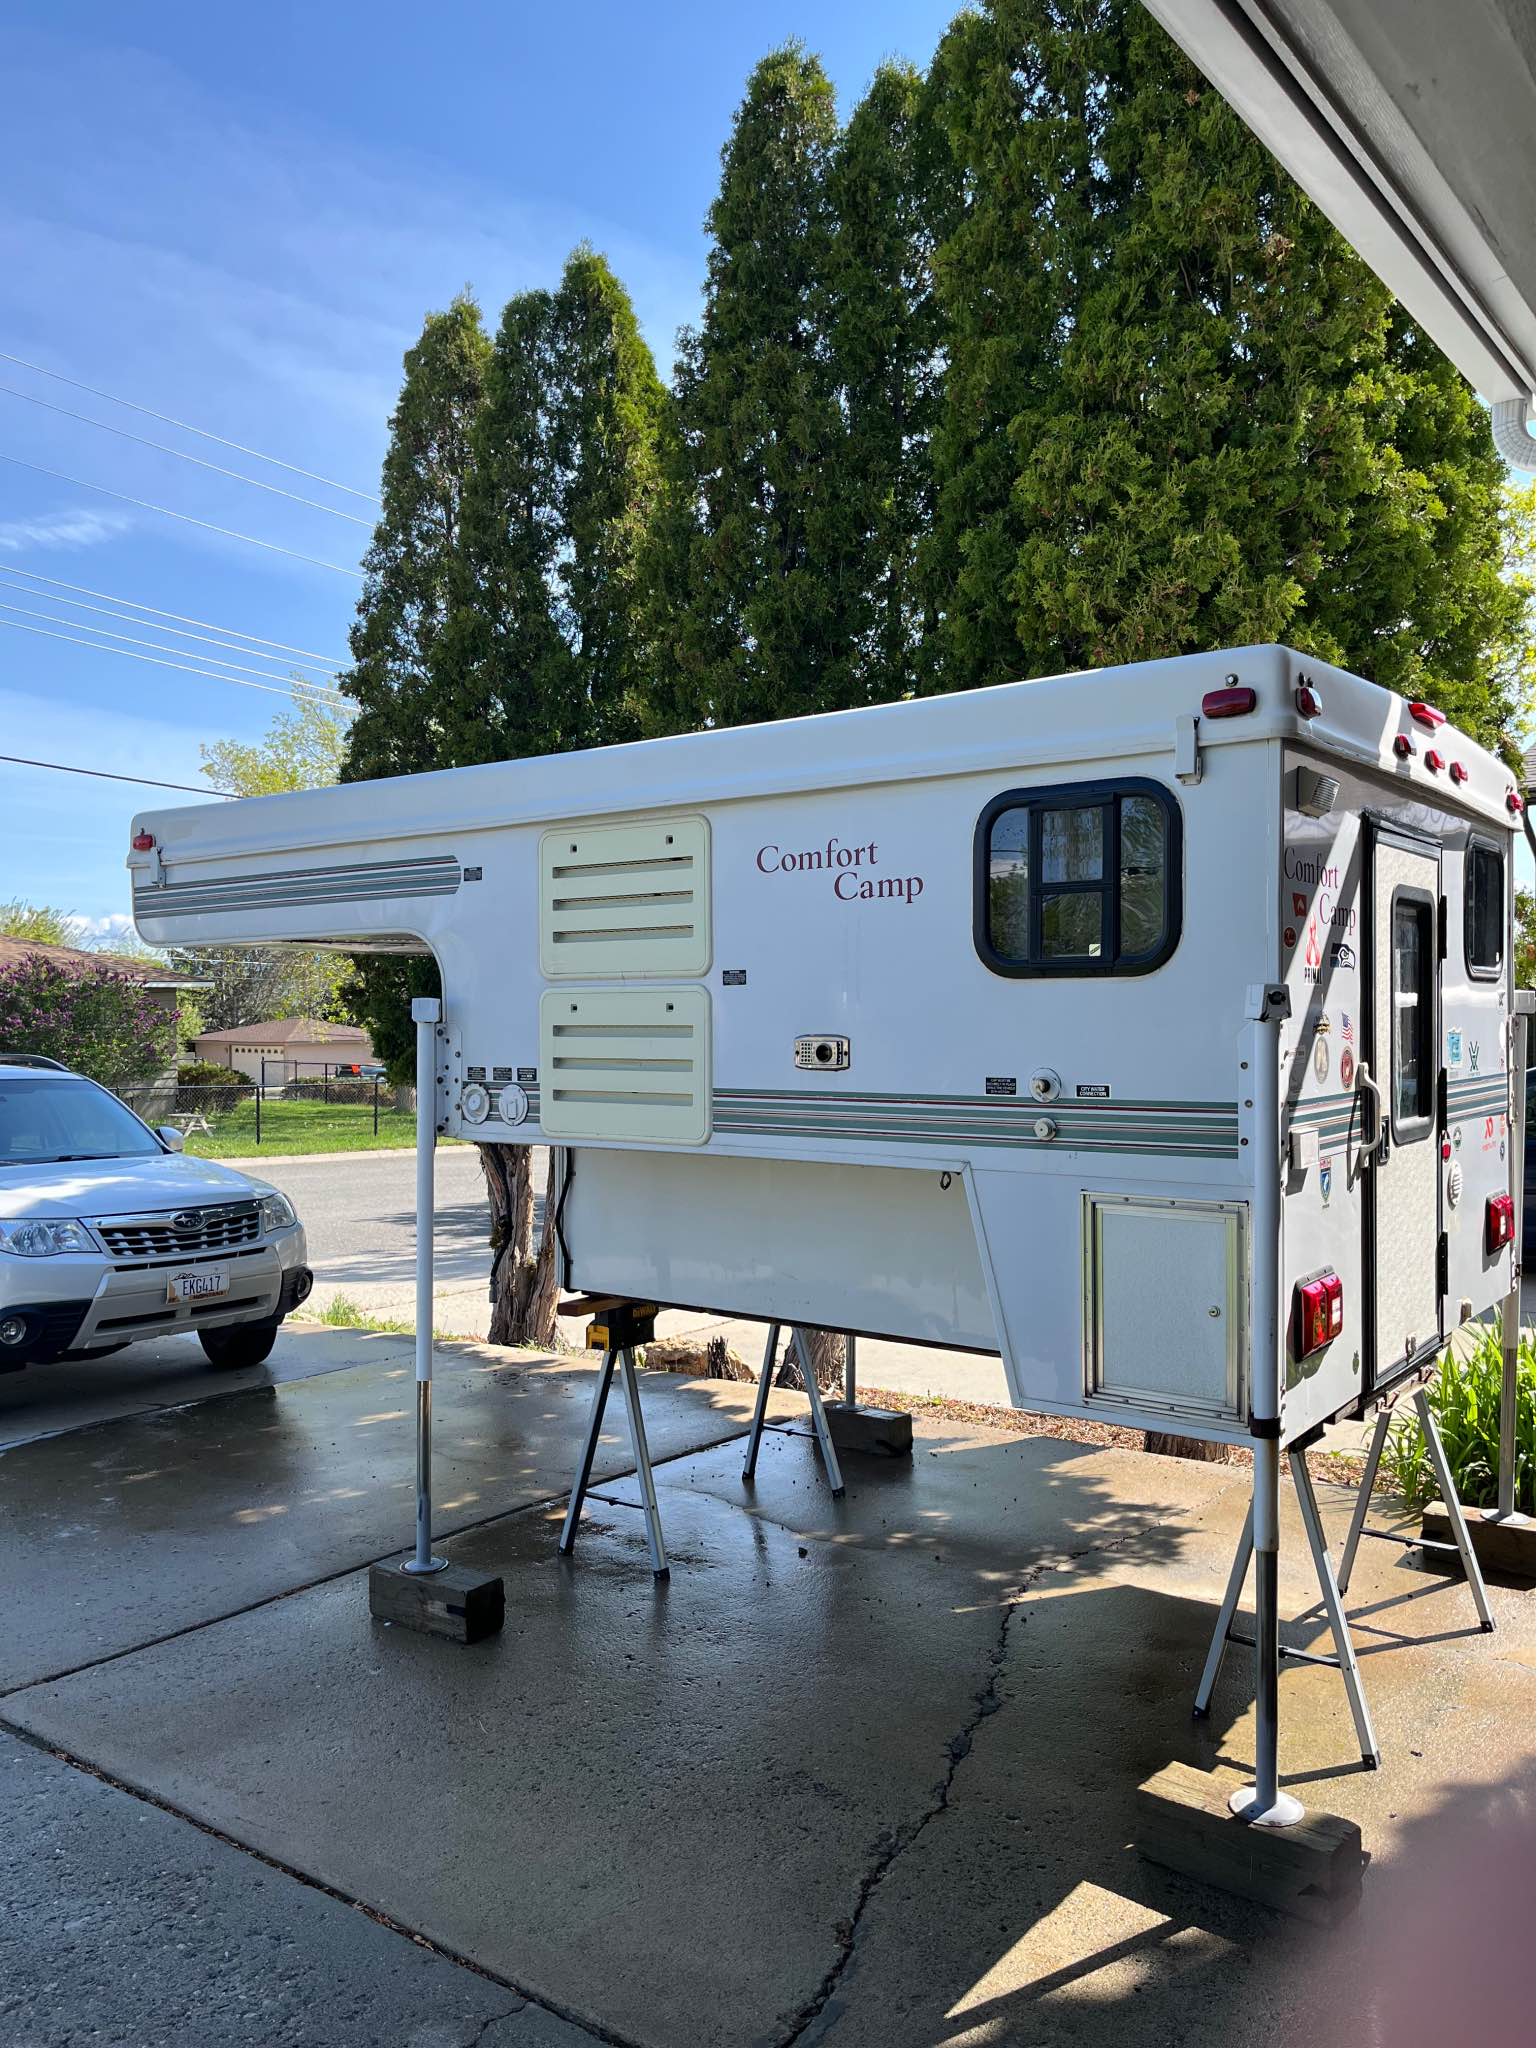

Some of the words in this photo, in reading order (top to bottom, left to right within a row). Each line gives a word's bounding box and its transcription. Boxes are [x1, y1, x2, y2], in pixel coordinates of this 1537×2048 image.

[756, 838, 879, 874] Comfort
[1284, 847, 1339, 890] Comfort
[833, 871, 924, 904] Camp
[1319, 892, 1356, 936] Camp
[182, 1275, 221, 1296] EKG417
